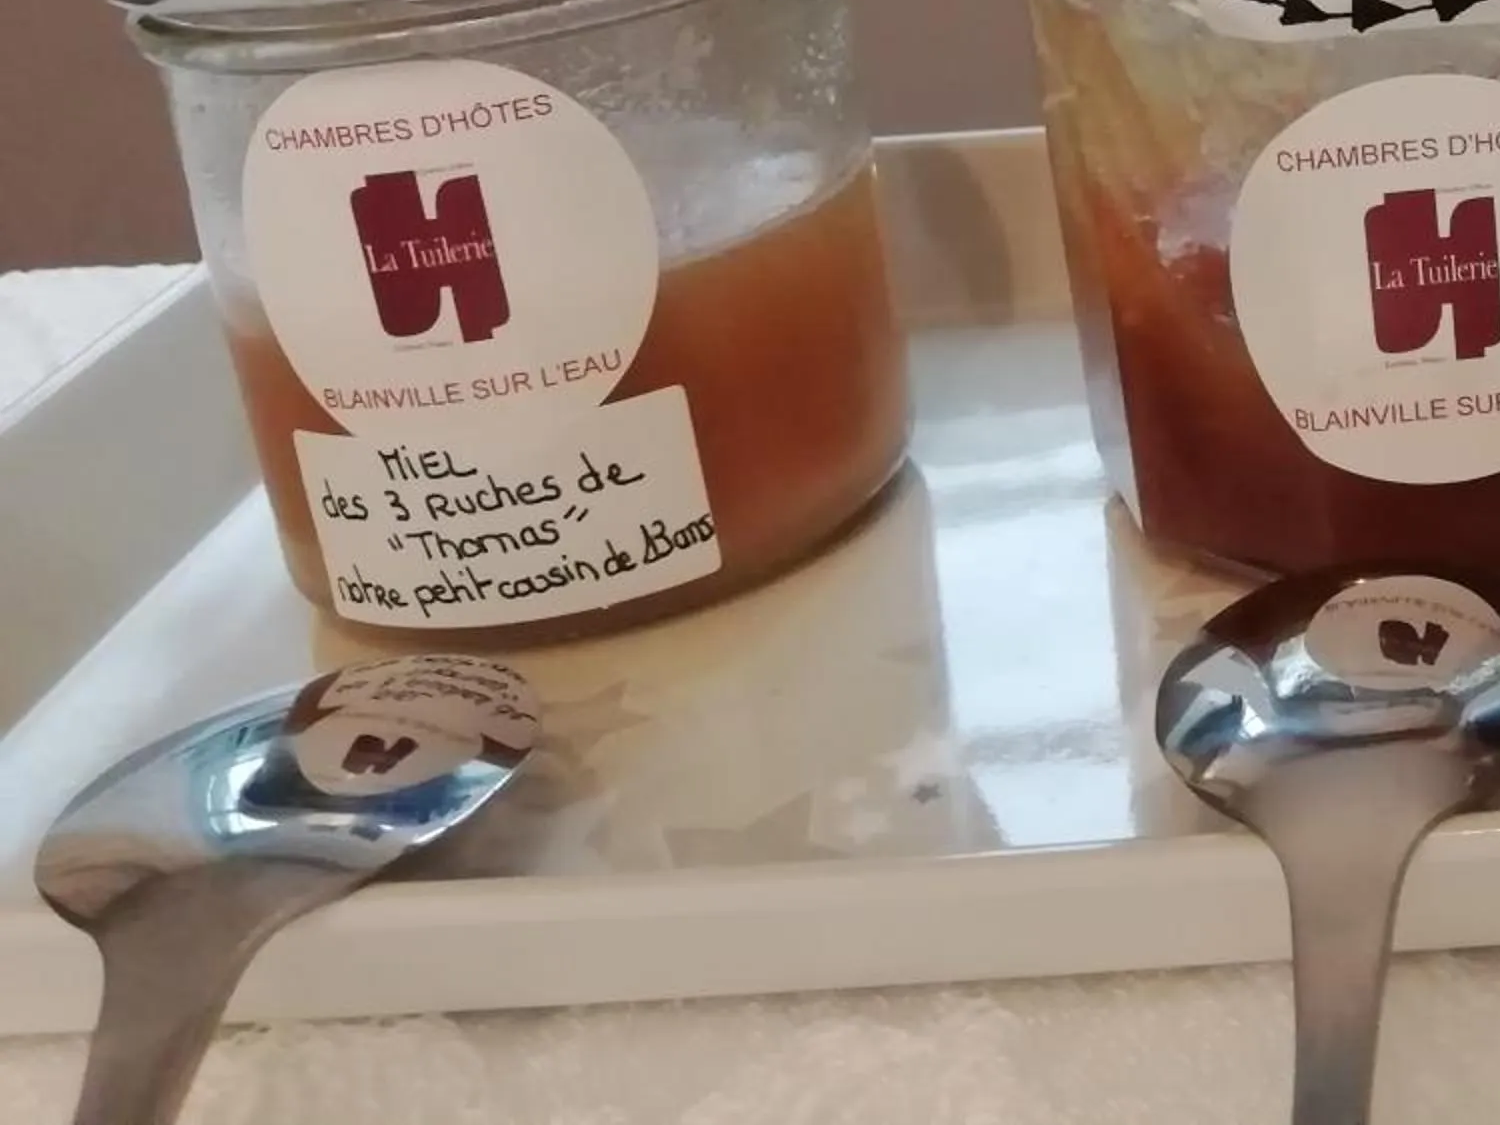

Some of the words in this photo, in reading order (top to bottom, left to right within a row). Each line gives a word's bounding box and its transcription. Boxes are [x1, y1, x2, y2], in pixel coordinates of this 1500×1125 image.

[264, 118, 414, 151] CHAMBRES
[421, 93, 555, 138] D'HÔTES
[1276, 137, 1440, 173] CHAMBRES
[364, 244, 400, 275] La
[400, 232, 496, 270] Tuilerie
[1372, 261, 1405, 291] La
[1409, 252, 1500, 287] Tuilerie
[323, 382, 466, 411] BLAINVILLE
[471, 371, 534, 402] SUR
[540, 348, 624, 388] L'EAU
[1294, 398, 1449, 434] BLAINVILLE
[321, 483, 368, 522] des
[382, 489, 411, 523] 3
[425, 474, 563, 521] Ruches
[576, 451, 646, 494] de
[603, 539, 636, 575] de
